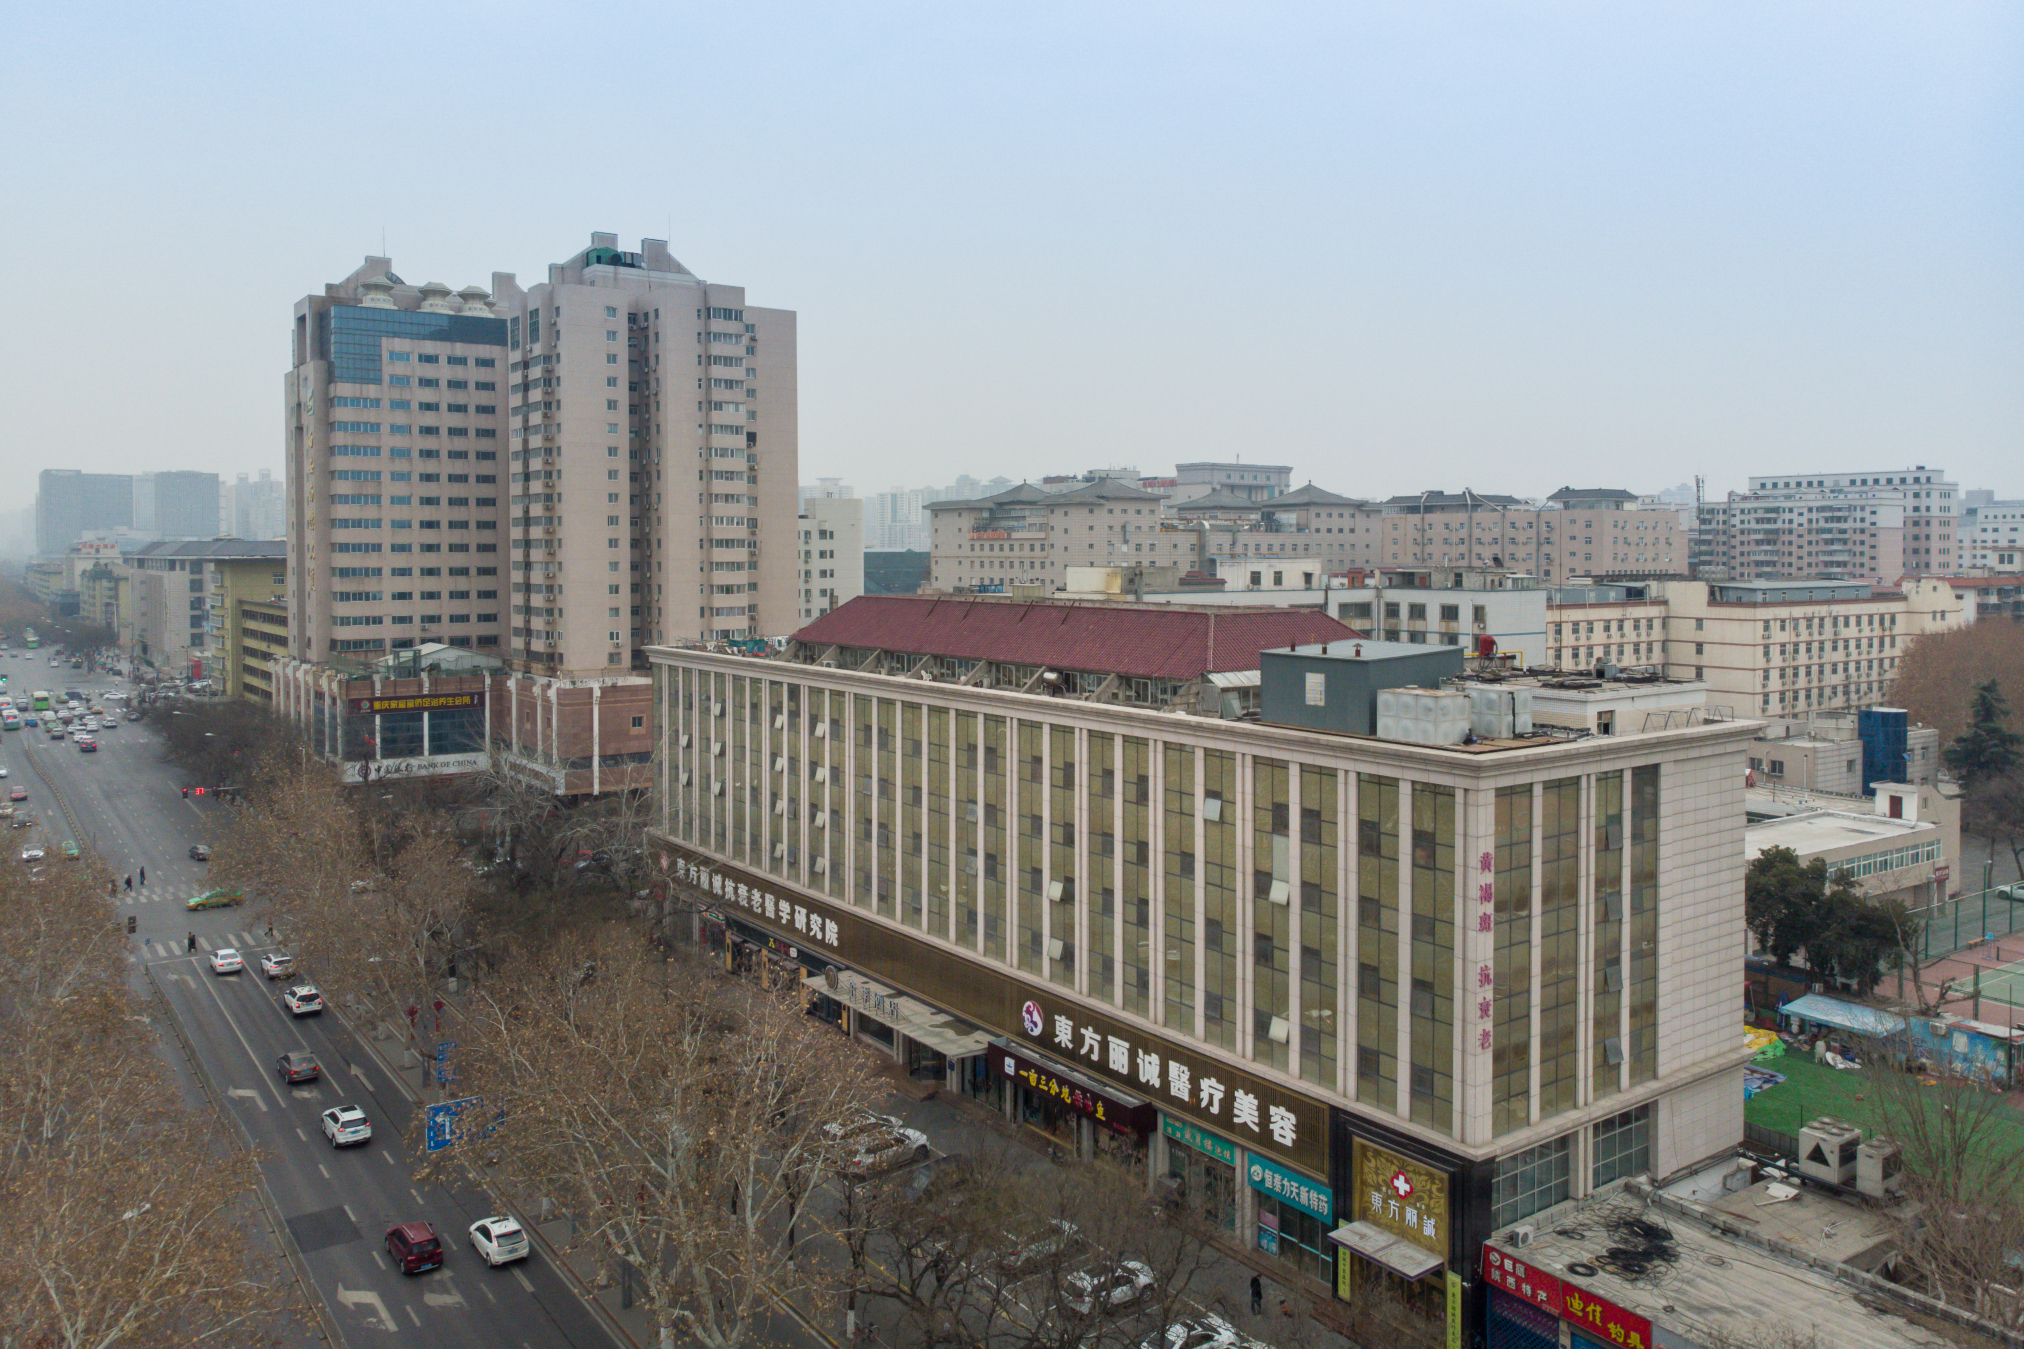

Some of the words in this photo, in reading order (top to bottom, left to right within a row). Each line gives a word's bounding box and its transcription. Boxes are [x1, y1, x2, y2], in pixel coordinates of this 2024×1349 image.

[418, 762, 438, 770] BANK
[452, 759, 477, 767] CHINA
[195, 787, 205, 796] 37
[1478, 964, 1493, 1050] 抗衰老
[1491, 1267, 1548, 1302] 陕西特产
[1565, 1292, 1645, 1349] 迪佳钓具
